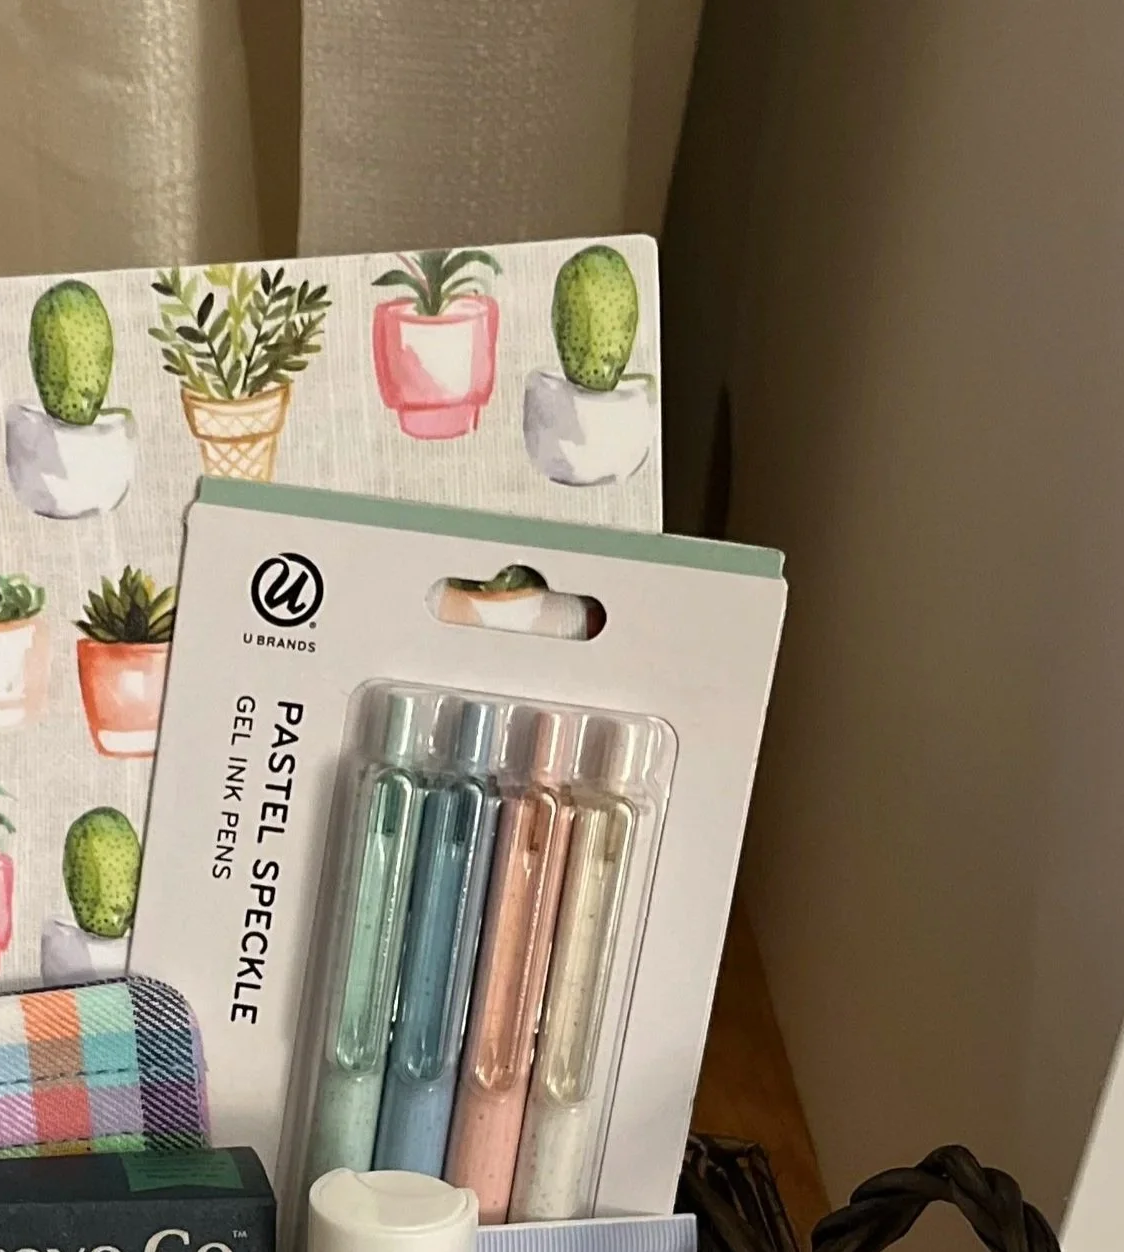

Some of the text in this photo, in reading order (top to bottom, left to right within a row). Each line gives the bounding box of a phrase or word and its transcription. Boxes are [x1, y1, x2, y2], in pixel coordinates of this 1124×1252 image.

[242, 632, 316, 653] U BRANDS
[211, 694, 256, 880] GEL INK PENS
[230, 700, 304, 1025] PASTEL SPECKLE
